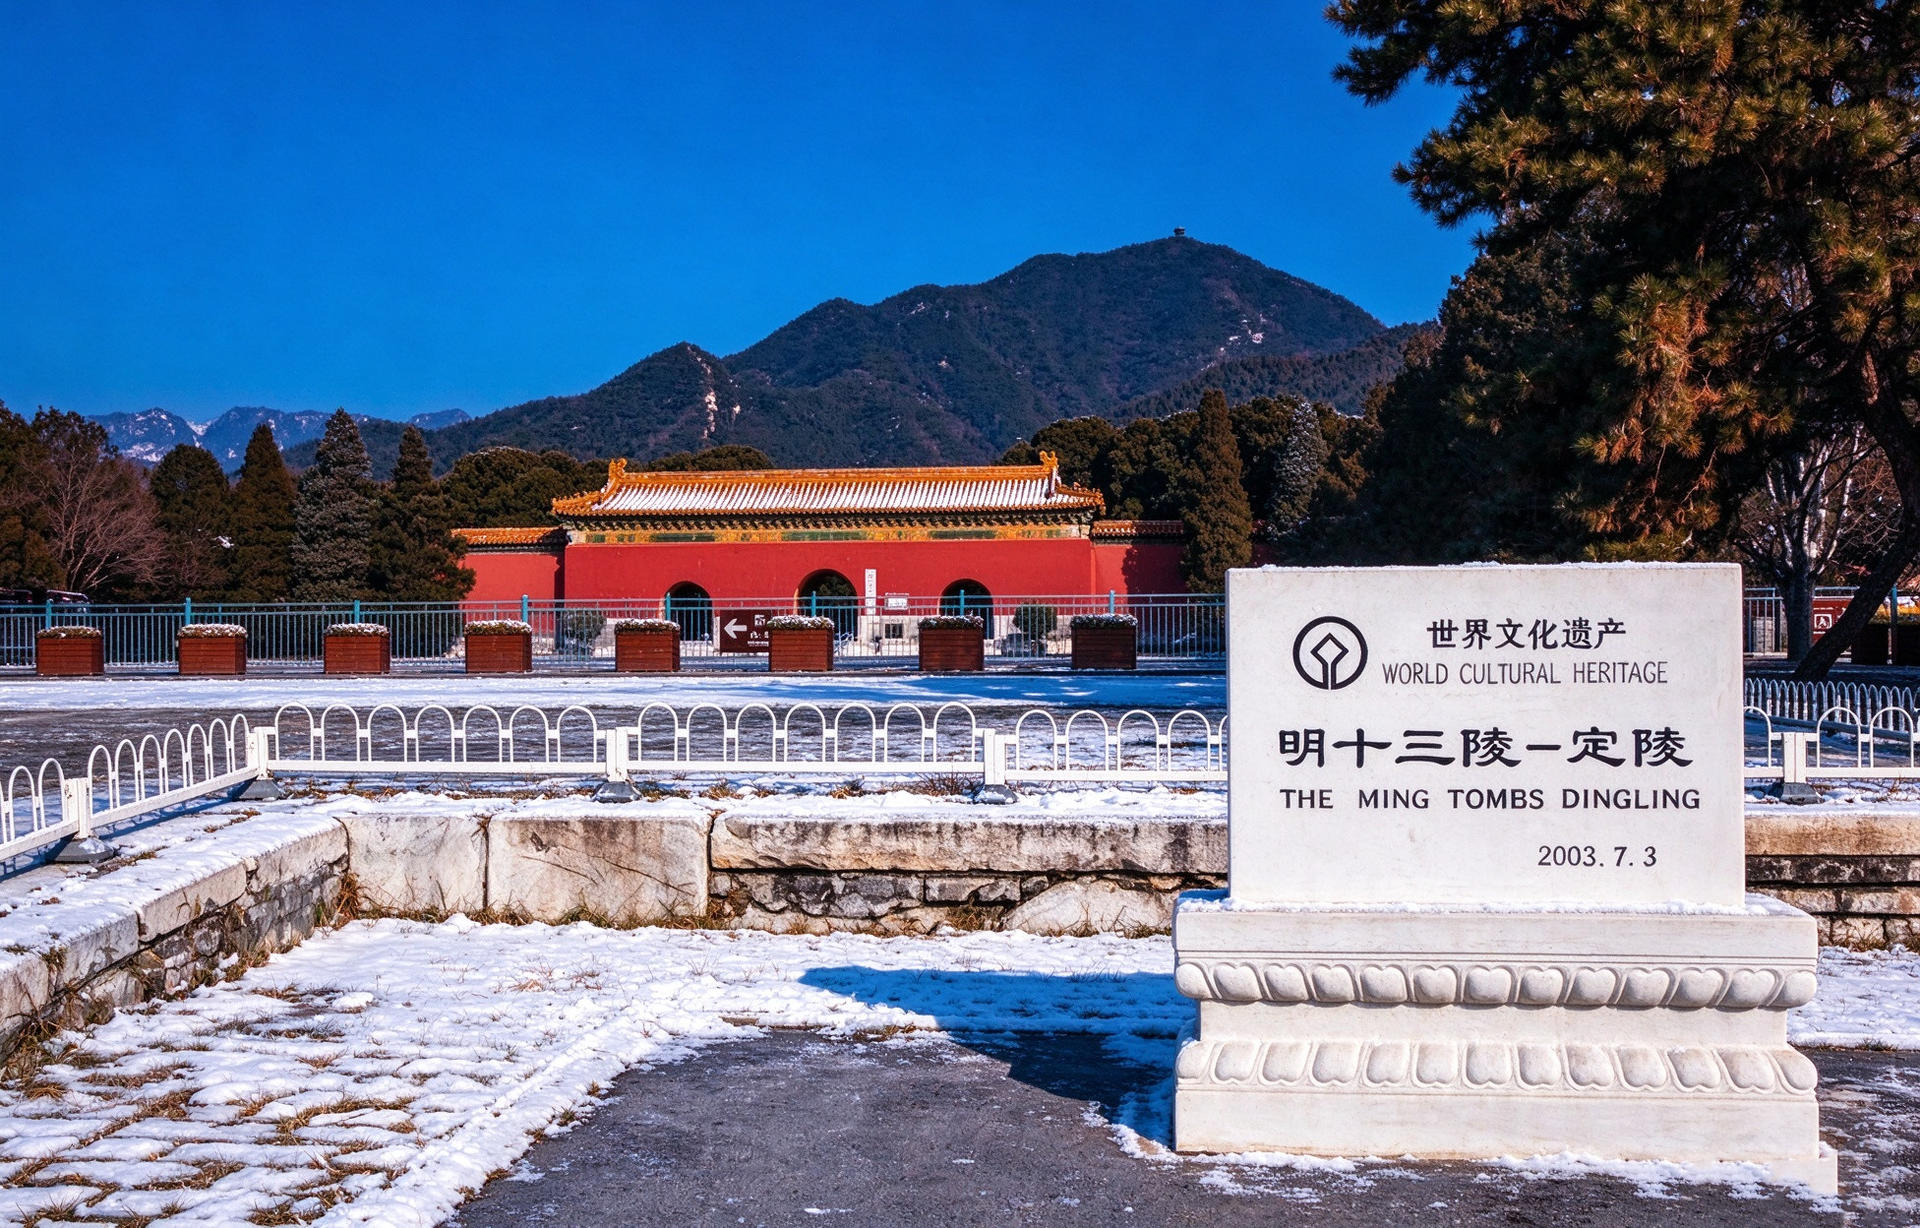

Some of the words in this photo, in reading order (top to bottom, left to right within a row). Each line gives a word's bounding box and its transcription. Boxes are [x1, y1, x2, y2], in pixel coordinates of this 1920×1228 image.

[1426, 616, 1627, 651] 世界文化遗产
[1382, 662, 1449, 685] WORLD
[1459, 662, 1562, 685] CULTURAL
[1573, 661, 1668, 684] HERITAGE
[1279, 788, 1334, 809] THE
[1358, 788, 1429, 809] MING
[1447, 788, 1545, 810] TOMBS
[1562, 788, 1700, 810] DINGLING
